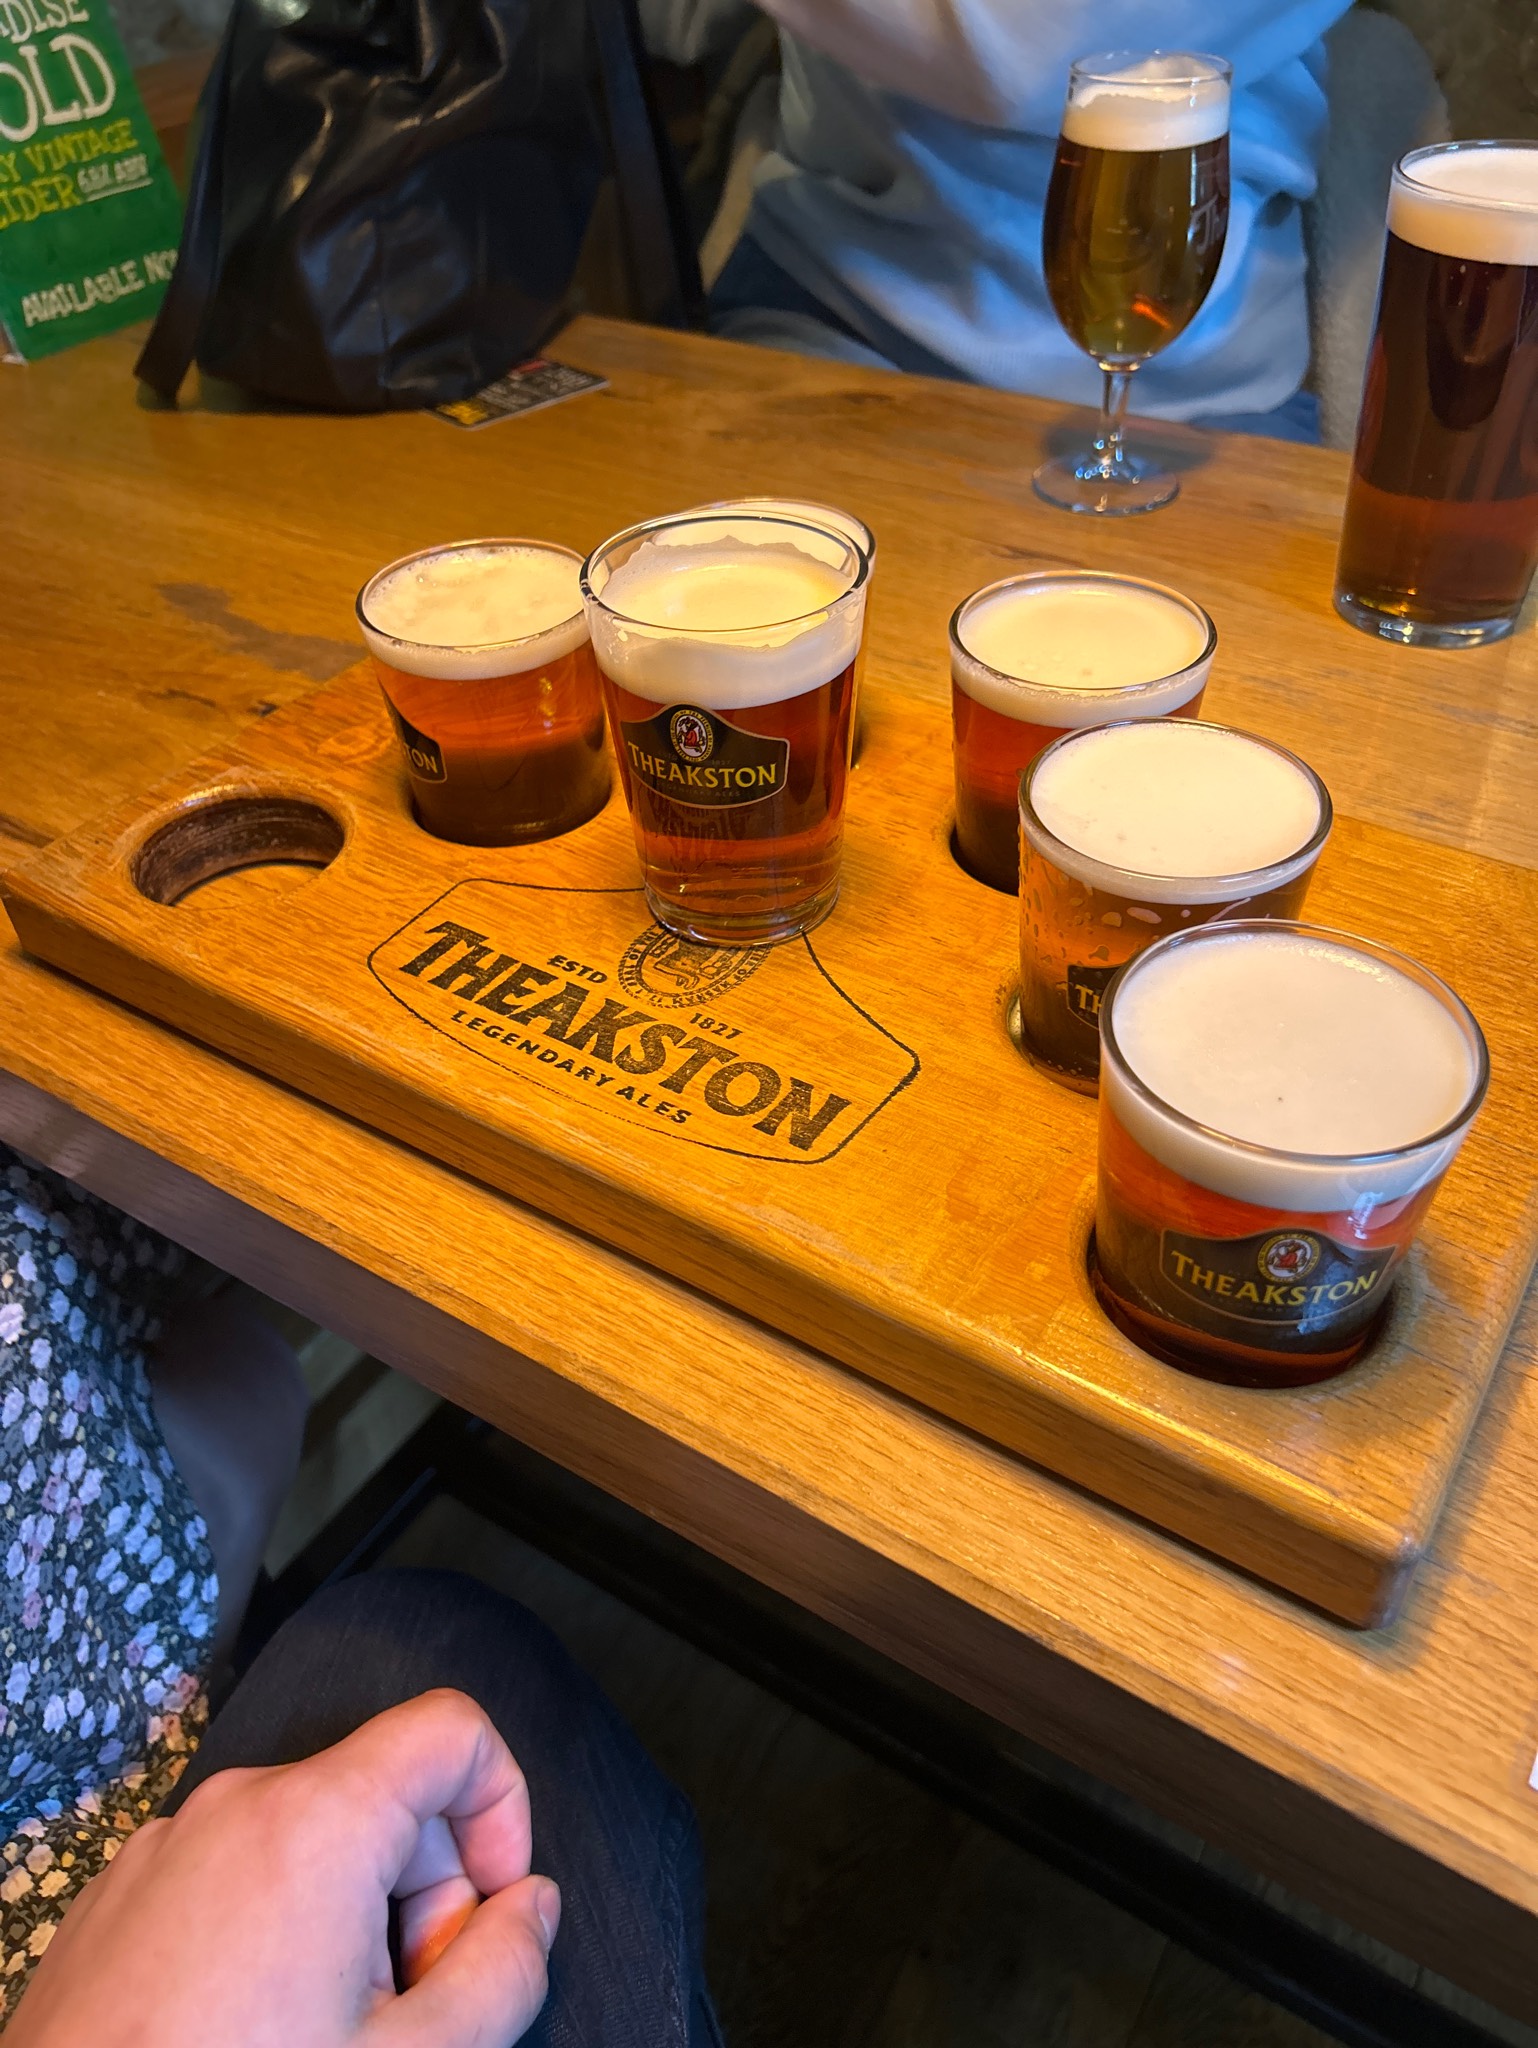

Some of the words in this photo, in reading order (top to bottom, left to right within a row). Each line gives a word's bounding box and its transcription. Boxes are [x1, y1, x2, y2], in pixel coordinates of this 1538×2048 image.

[0, 0, 89, 43] DISE
[0, 33, 116, 142] OLD
[25, 118, 138, 173] VINTAGE
[0, 173, 82, 230] IDER
[21, 259, 145, 329] AVAILABLE
[143, 249, 179, 285] NO
[627, 741, 777, 789] THEAKSTON
[546, 954, 608, 985] ESTD
[690, 1012, 743, 1041] 1827
[399, 920, 852, 1152] THEAKSTON
[450, 1009, 616, 1087] LEGENDARY
[615, 1084, 692, 1125] ALES
[1170, 1250, 1378, 1306] THEAKSTON
